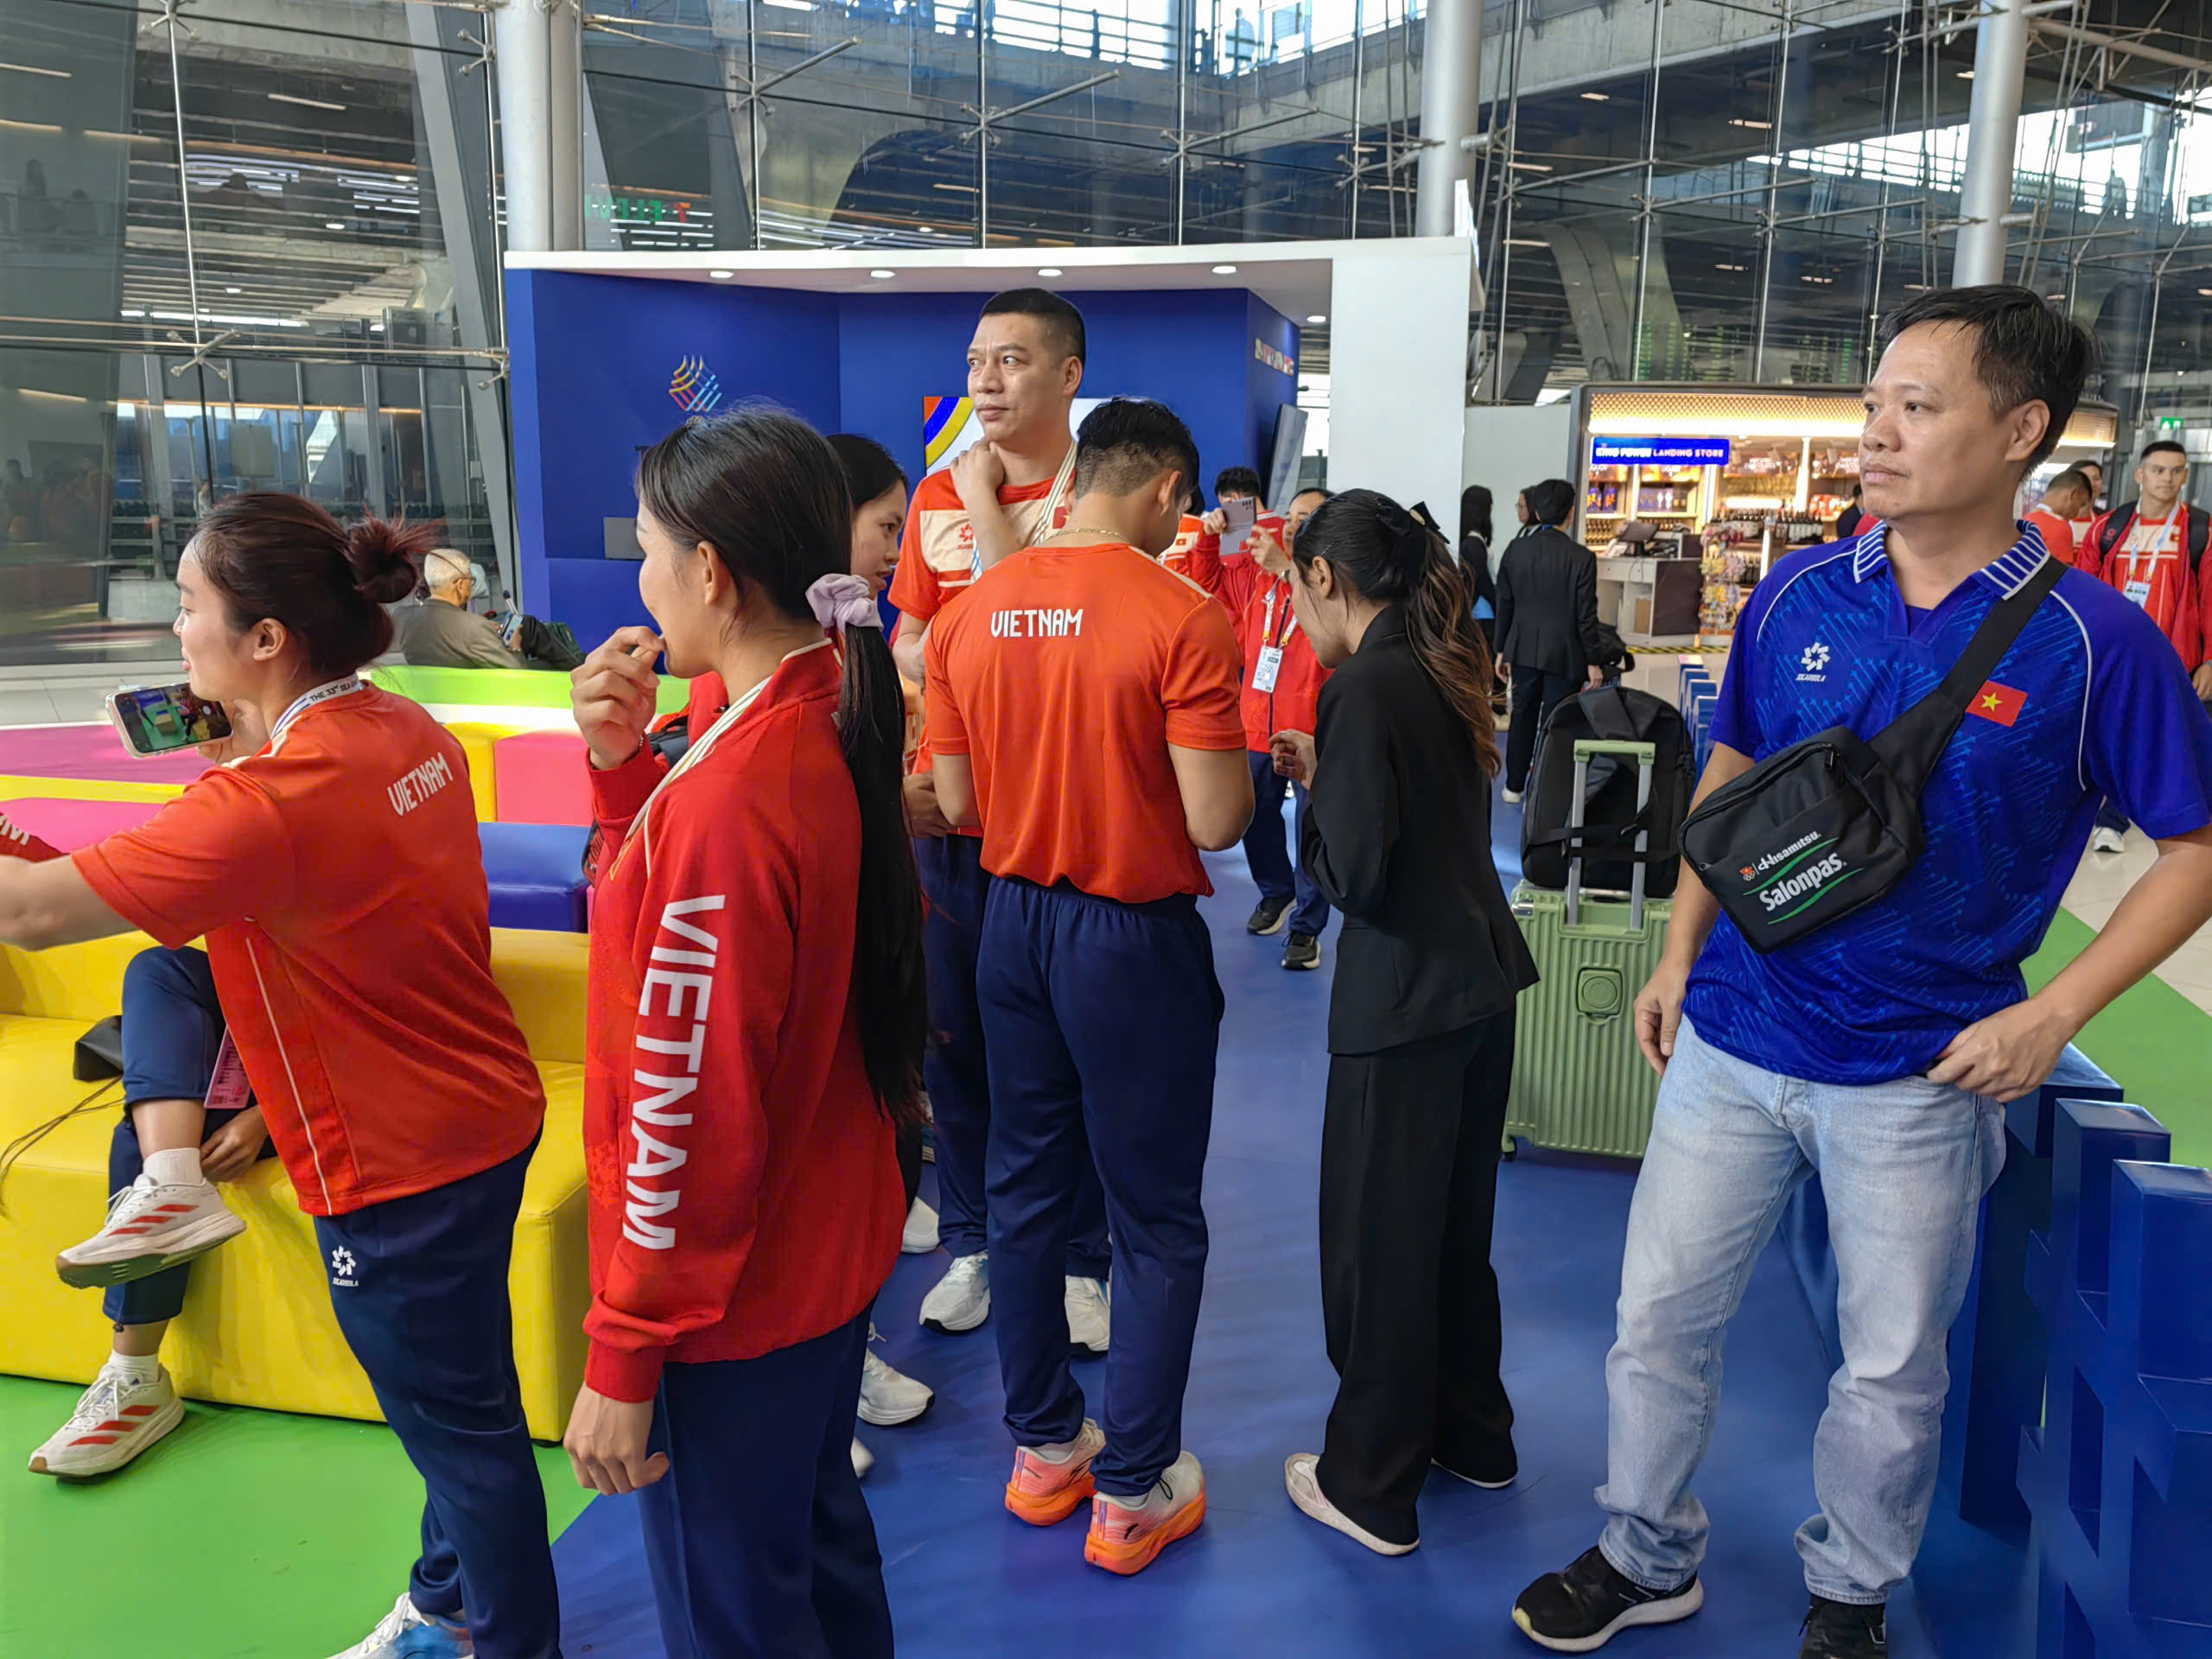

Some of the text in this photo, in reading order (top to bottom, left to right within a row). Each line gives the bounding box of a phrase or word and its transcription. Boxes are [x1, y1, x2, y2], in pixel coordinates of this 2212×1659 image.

[1653, 448, 1693, 457] LANDING
[1695, 448, 1724, 457] STORE
[990, 607, 1084, 638] VIETNAM
[309, 691, 326, 702] THE
[387, 752, 454, 816] VIETNAM
[622, 894, 726, 1250] VIETNAM
